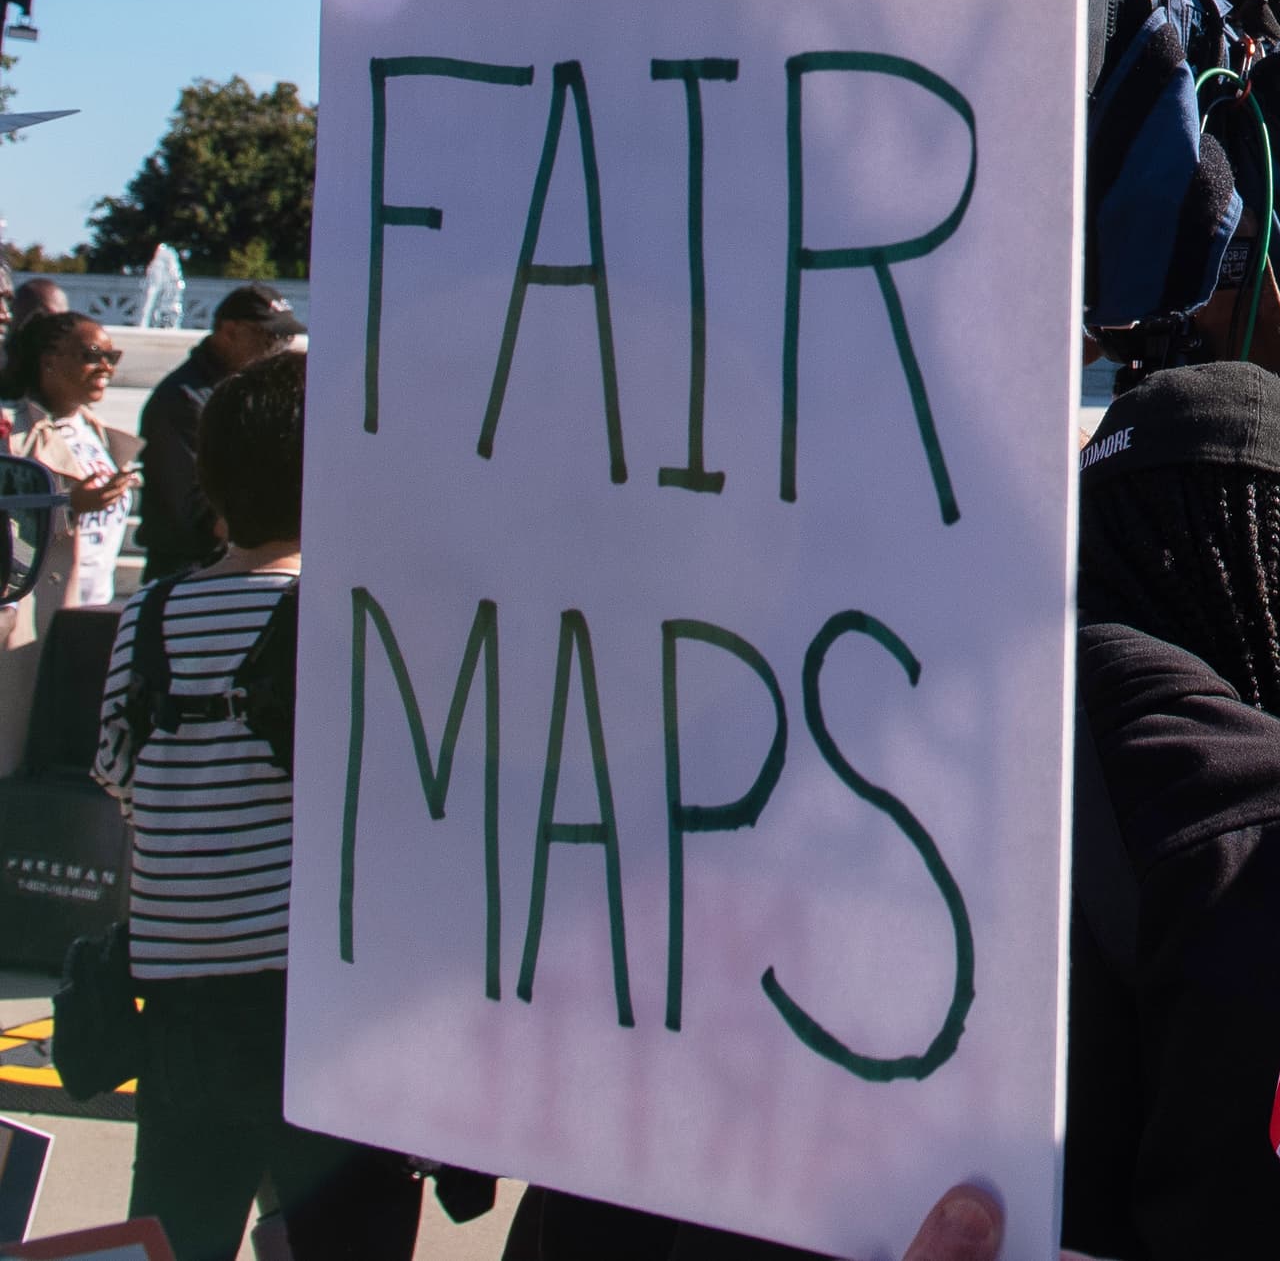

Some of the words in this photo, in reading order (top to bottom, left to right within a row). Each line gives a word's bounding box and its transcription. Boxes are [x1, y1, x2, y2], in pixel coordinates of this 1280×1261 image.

[363, 50, 978, 526] FAIR
[1079, 426, 1135, 472] LTIMORE
[338, 587, 974, 1083] MAPS
